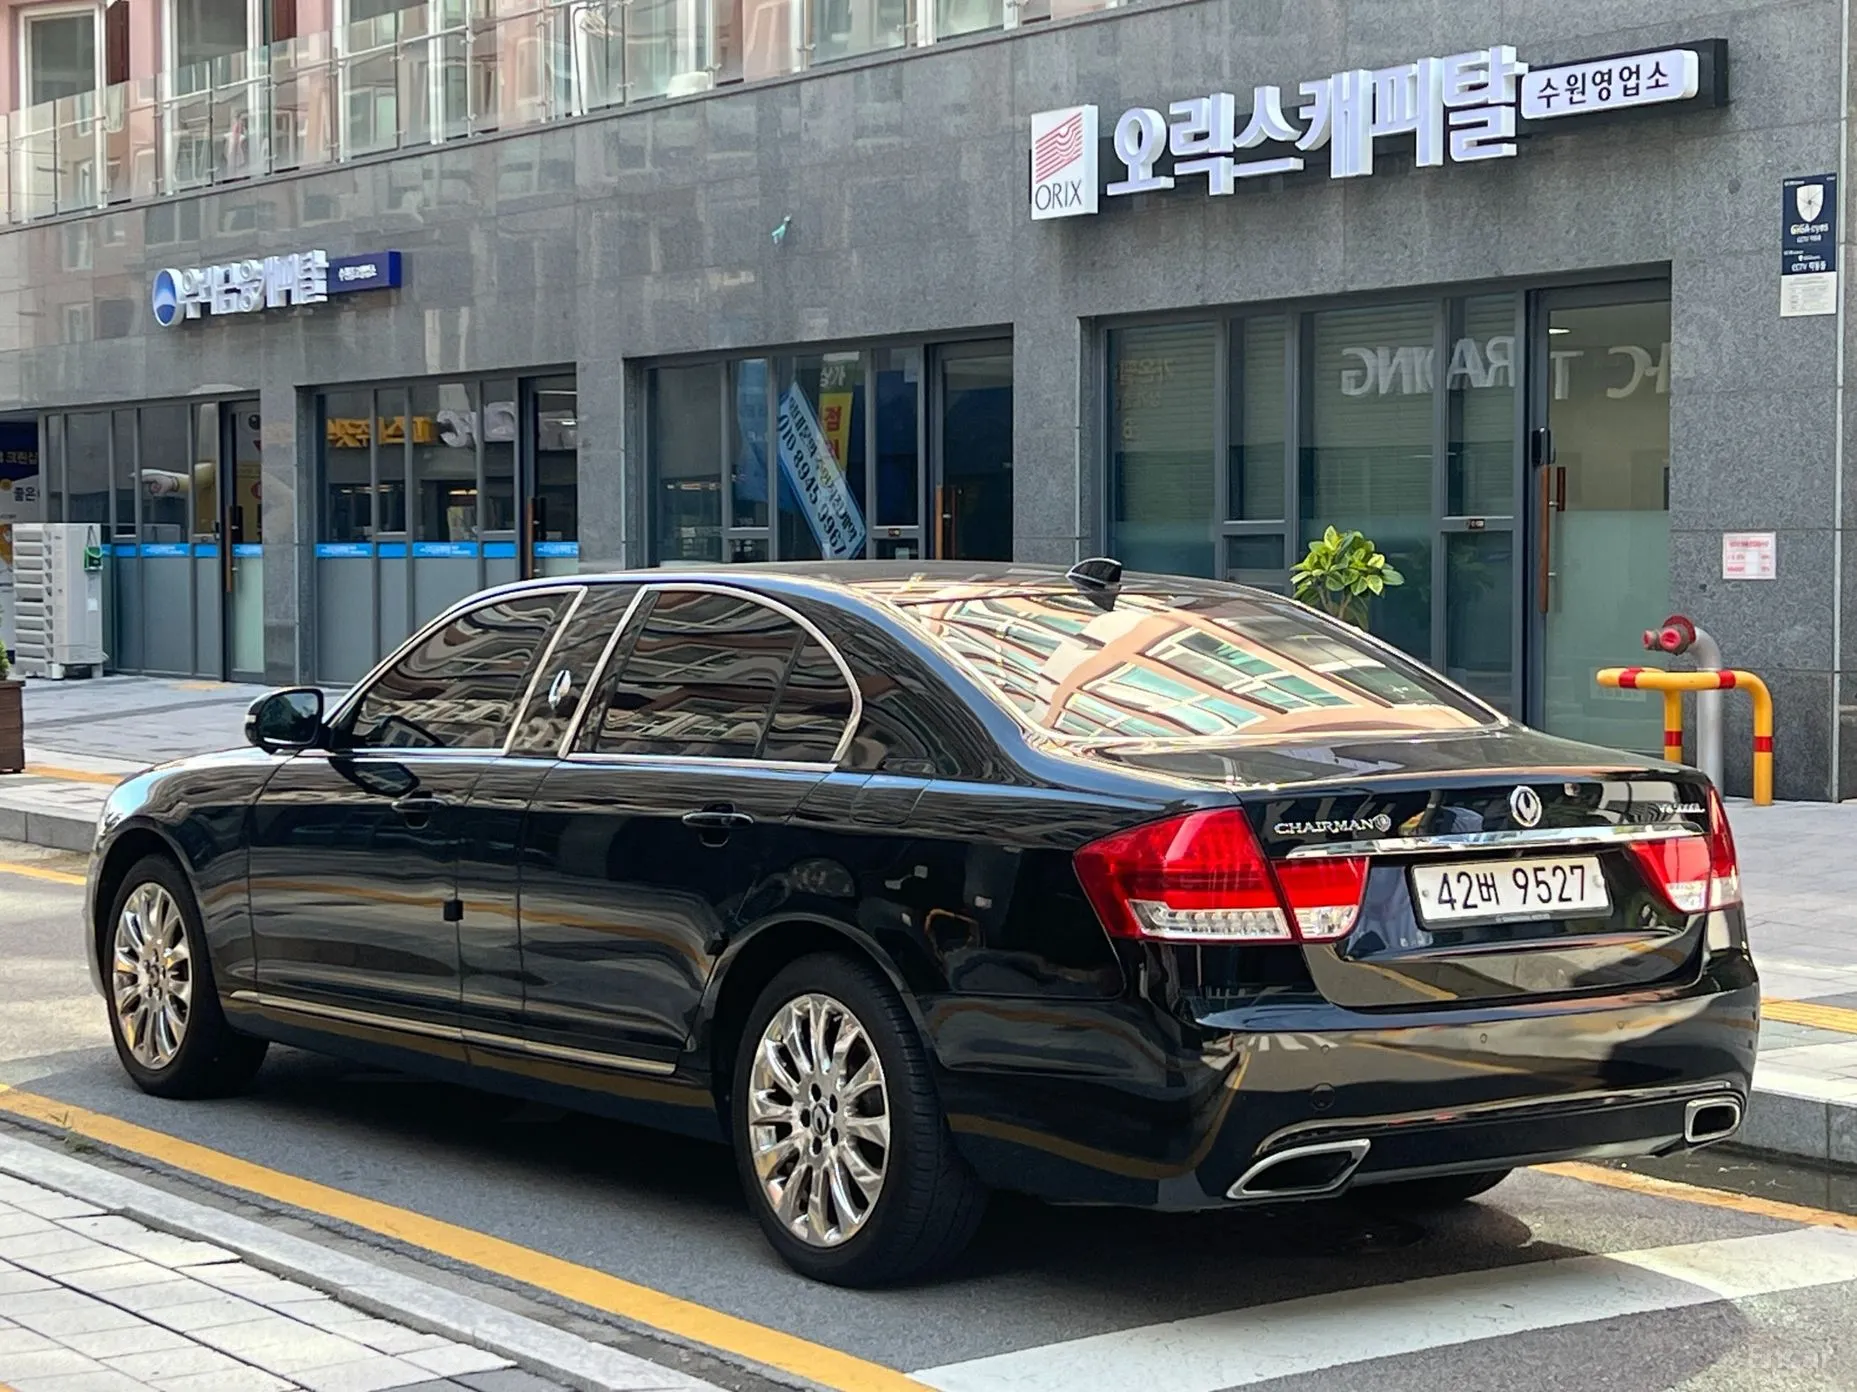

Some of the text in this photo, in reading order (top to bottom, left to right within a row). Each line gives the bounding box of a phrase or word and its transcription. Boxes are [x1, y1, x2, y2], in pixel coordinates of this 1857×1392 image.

[1536, 62, 1671, 105] 수원영업소
[1106, 45, 1530, 196] 오릭스캐피탈
[1034, 181, 1083, 211] ORIX
[777, 414, 797, 451] 010
[793, 450, 821, 505] 8945
[817, 503, 847, 555] 9967
[1274, 818, 1376, 835] CHAIRMAN
[1437, 864, 1587, 912] 42버 9527
